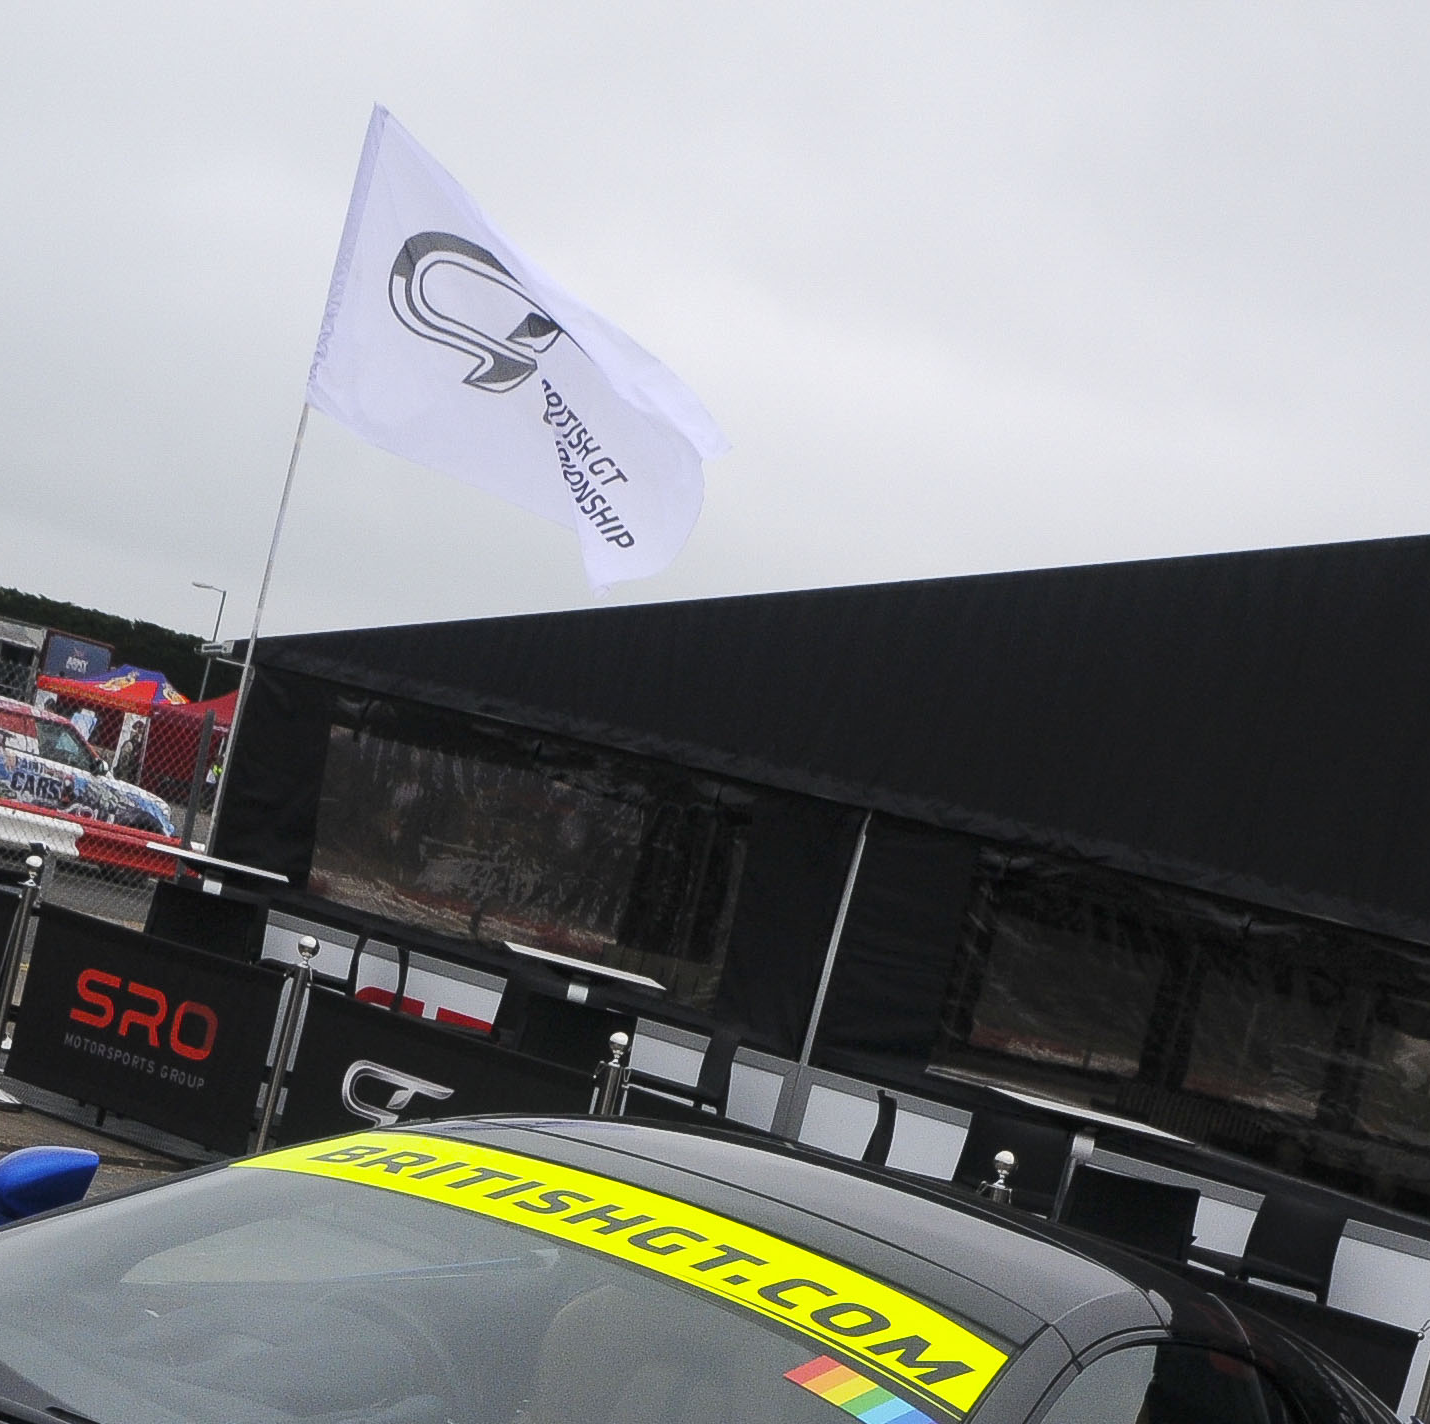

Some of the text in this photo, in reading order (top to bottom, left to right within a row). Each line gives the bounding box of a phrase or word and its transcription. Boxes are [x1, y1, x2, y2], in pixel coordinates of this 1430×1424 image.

[588, 457, 629, 485] GT
[11, 771, 63, 800] CARS
[69, 968, 219, 1061] SRO
[64, 1032, 205, 1091] MOTORSPORTS GROUP
[307, 1143, 977, 1386] BRITISHGT.COM
